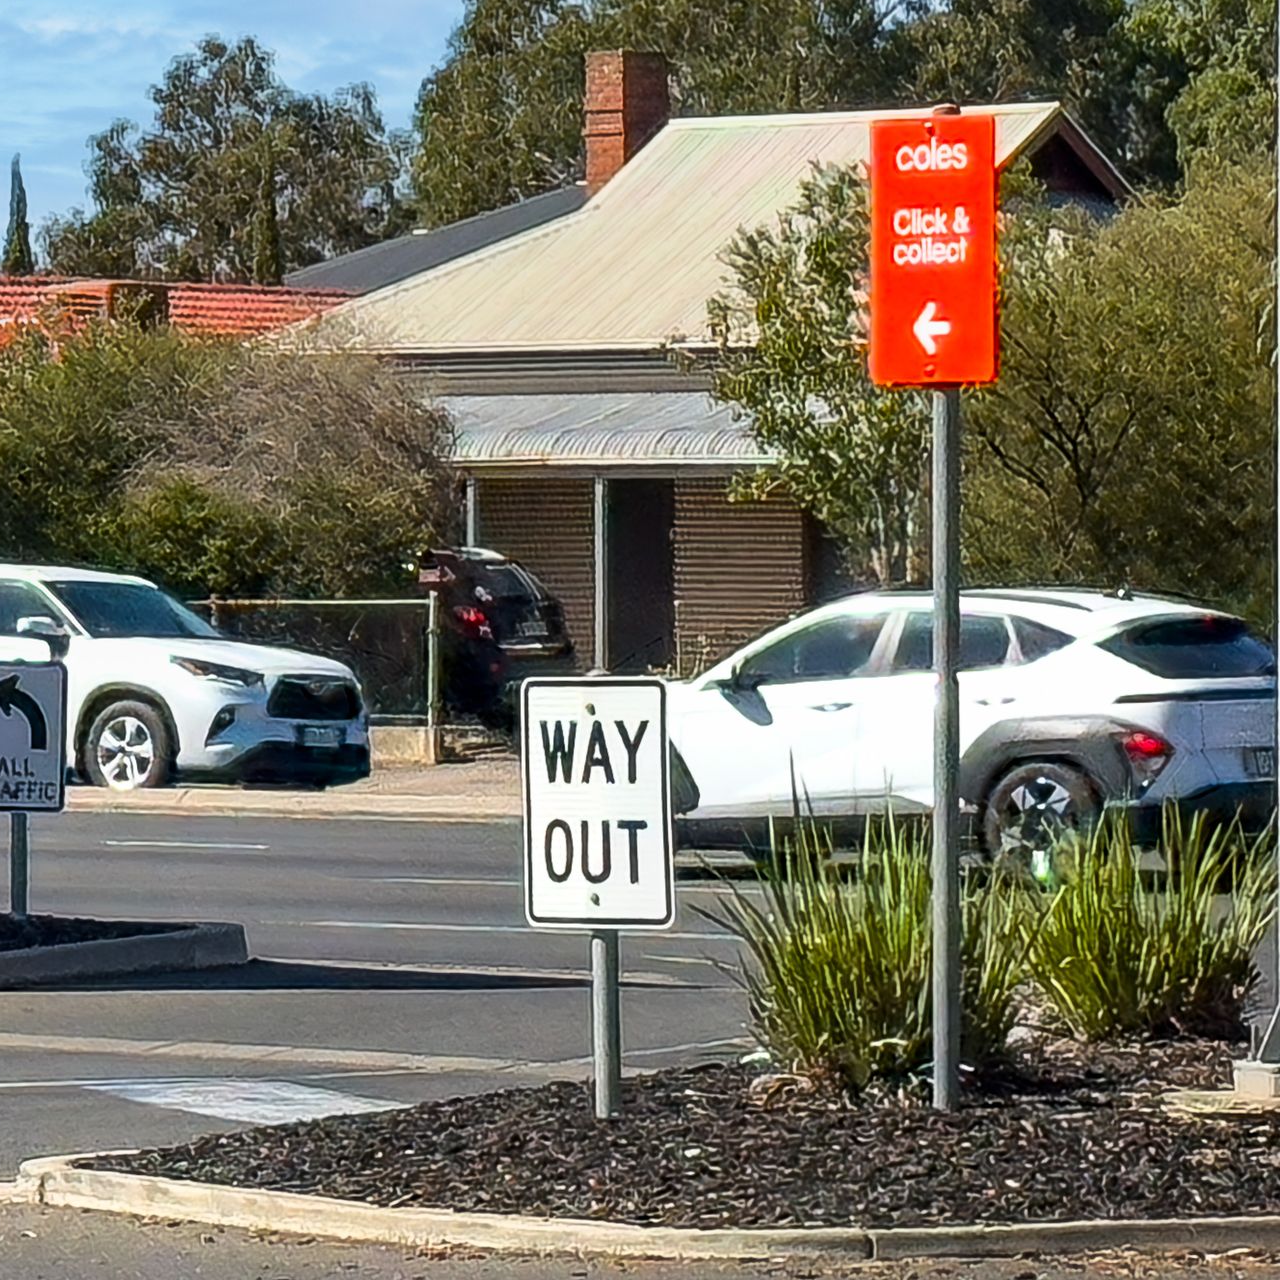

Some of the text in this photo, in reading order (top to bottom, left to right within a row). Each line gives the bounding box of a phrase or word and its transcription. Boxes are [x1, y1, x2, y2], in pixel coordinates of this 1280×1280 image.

[896, 136, 968, 171] coles
[893, 206, 970, 236] Click &
[893, 237, 968, 265] collect
[540, 720, 649, 784] WAY
[544, 819, 648, 884] OUT
